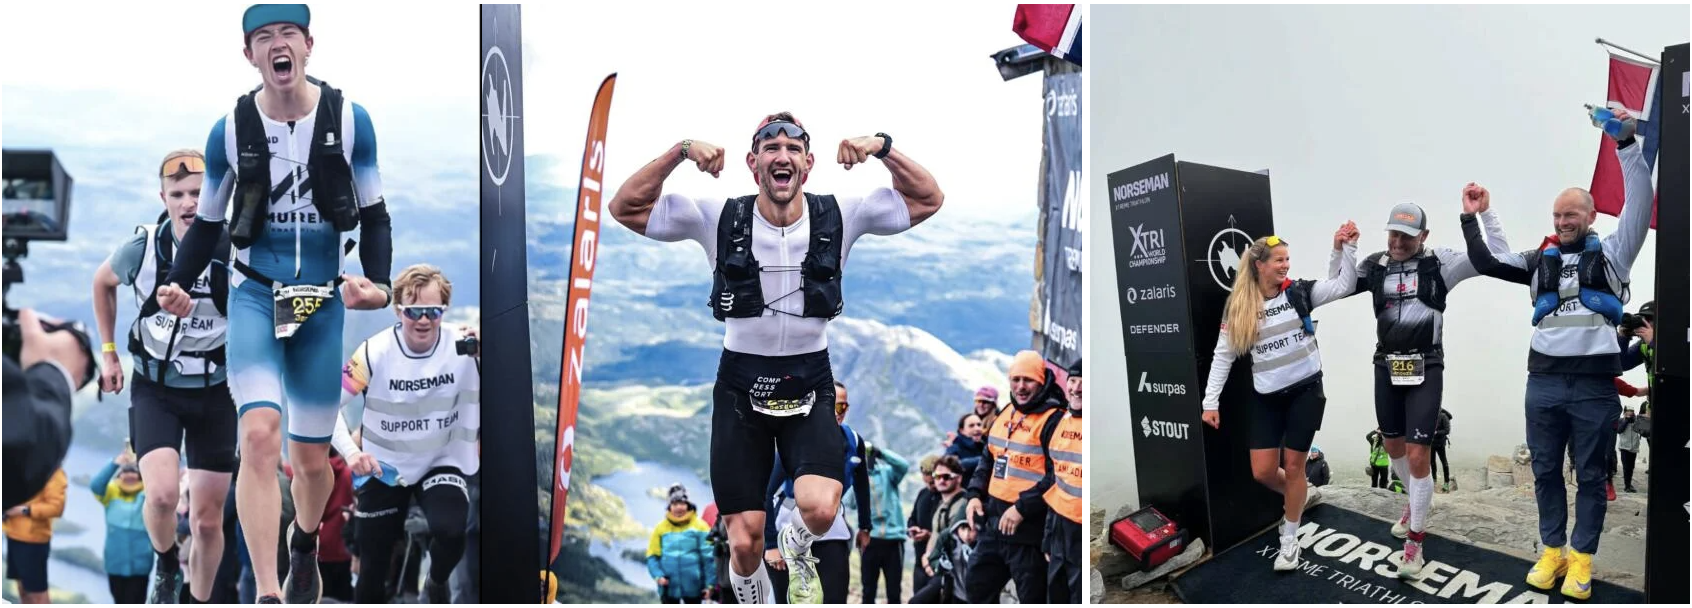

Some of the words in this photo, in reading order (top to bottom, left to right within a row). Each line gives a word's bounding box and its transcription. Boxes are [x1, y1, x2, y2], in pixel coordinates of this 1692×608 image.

[1113, 172, 1169, 201] NORSEMAN
[1128, 223, 1165, 258] XTRI
[1149, 249, 1166, 257] WORLD
[568, 140, 605, 385] zalaris
[1129, 256, 1166, 269] CHAMPIONSHIP
[1140, 284, 1176, 301] zalaris
[1130, 323, 1180, 334] DEFENDER
[1256, 338, 1289, 354] SUPPORT
[1392, 361, 1414, 371] 216
[389, 373, 455, 391] NORSEMAN
[757, 376, 781, 384] COMP
[1153, 381, 1187, 396] surpas
[380, 418, 430, 433] SUPPORT
[436, 411, 459, 430] TEAM
[1152, 420, 1190, 440] STOUT
[1328, 569, 1425, 604] TRIATHL
